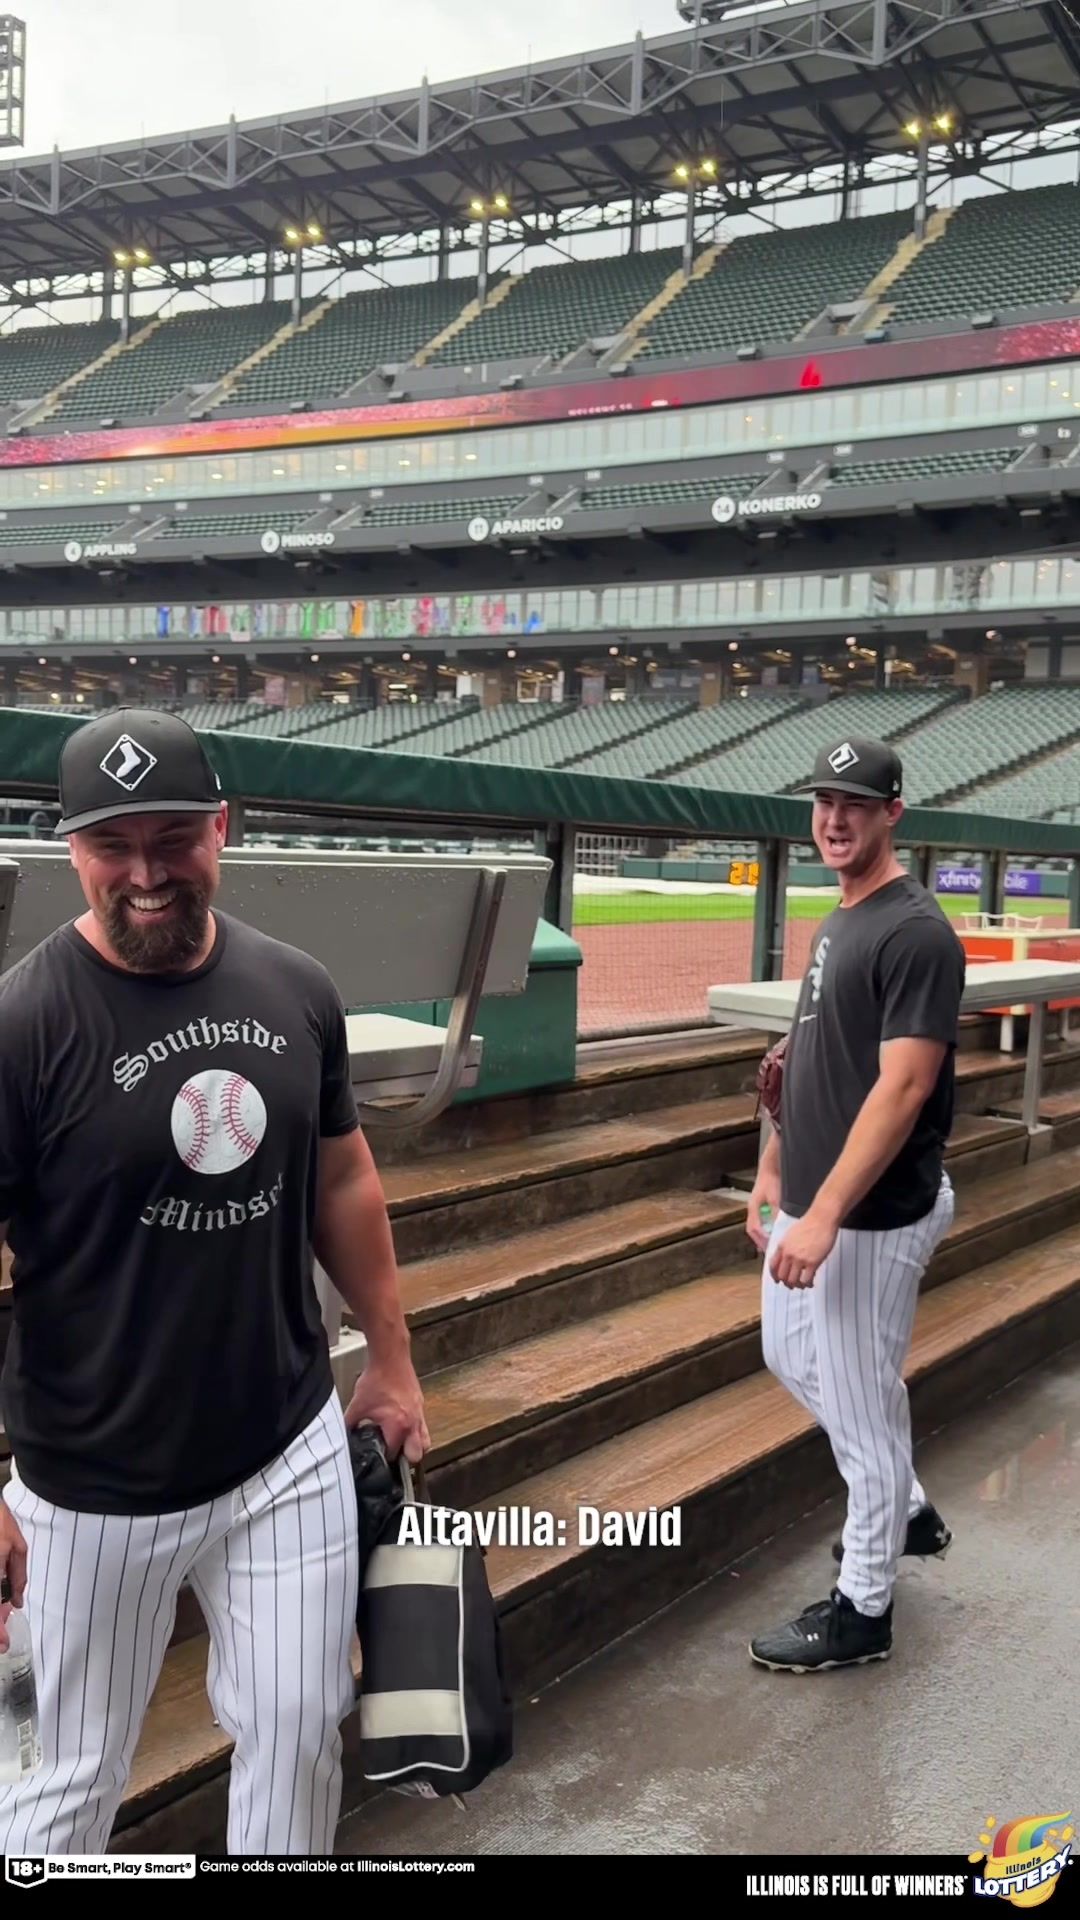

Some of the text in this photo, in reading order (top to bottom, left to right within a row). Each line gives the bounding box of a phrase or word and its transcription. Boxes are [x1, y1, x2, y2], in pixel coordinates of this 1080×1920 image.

[738, 493, 822, 516] KONERKO
[491, 516, 564, 535] APARICIO
[281, 532, 335, 547] MINOSO
[83, 543, 137, 557] APPLING
[1004, 873, 1029, 889] bile
[112, 1016, 288, 1092] Southside
